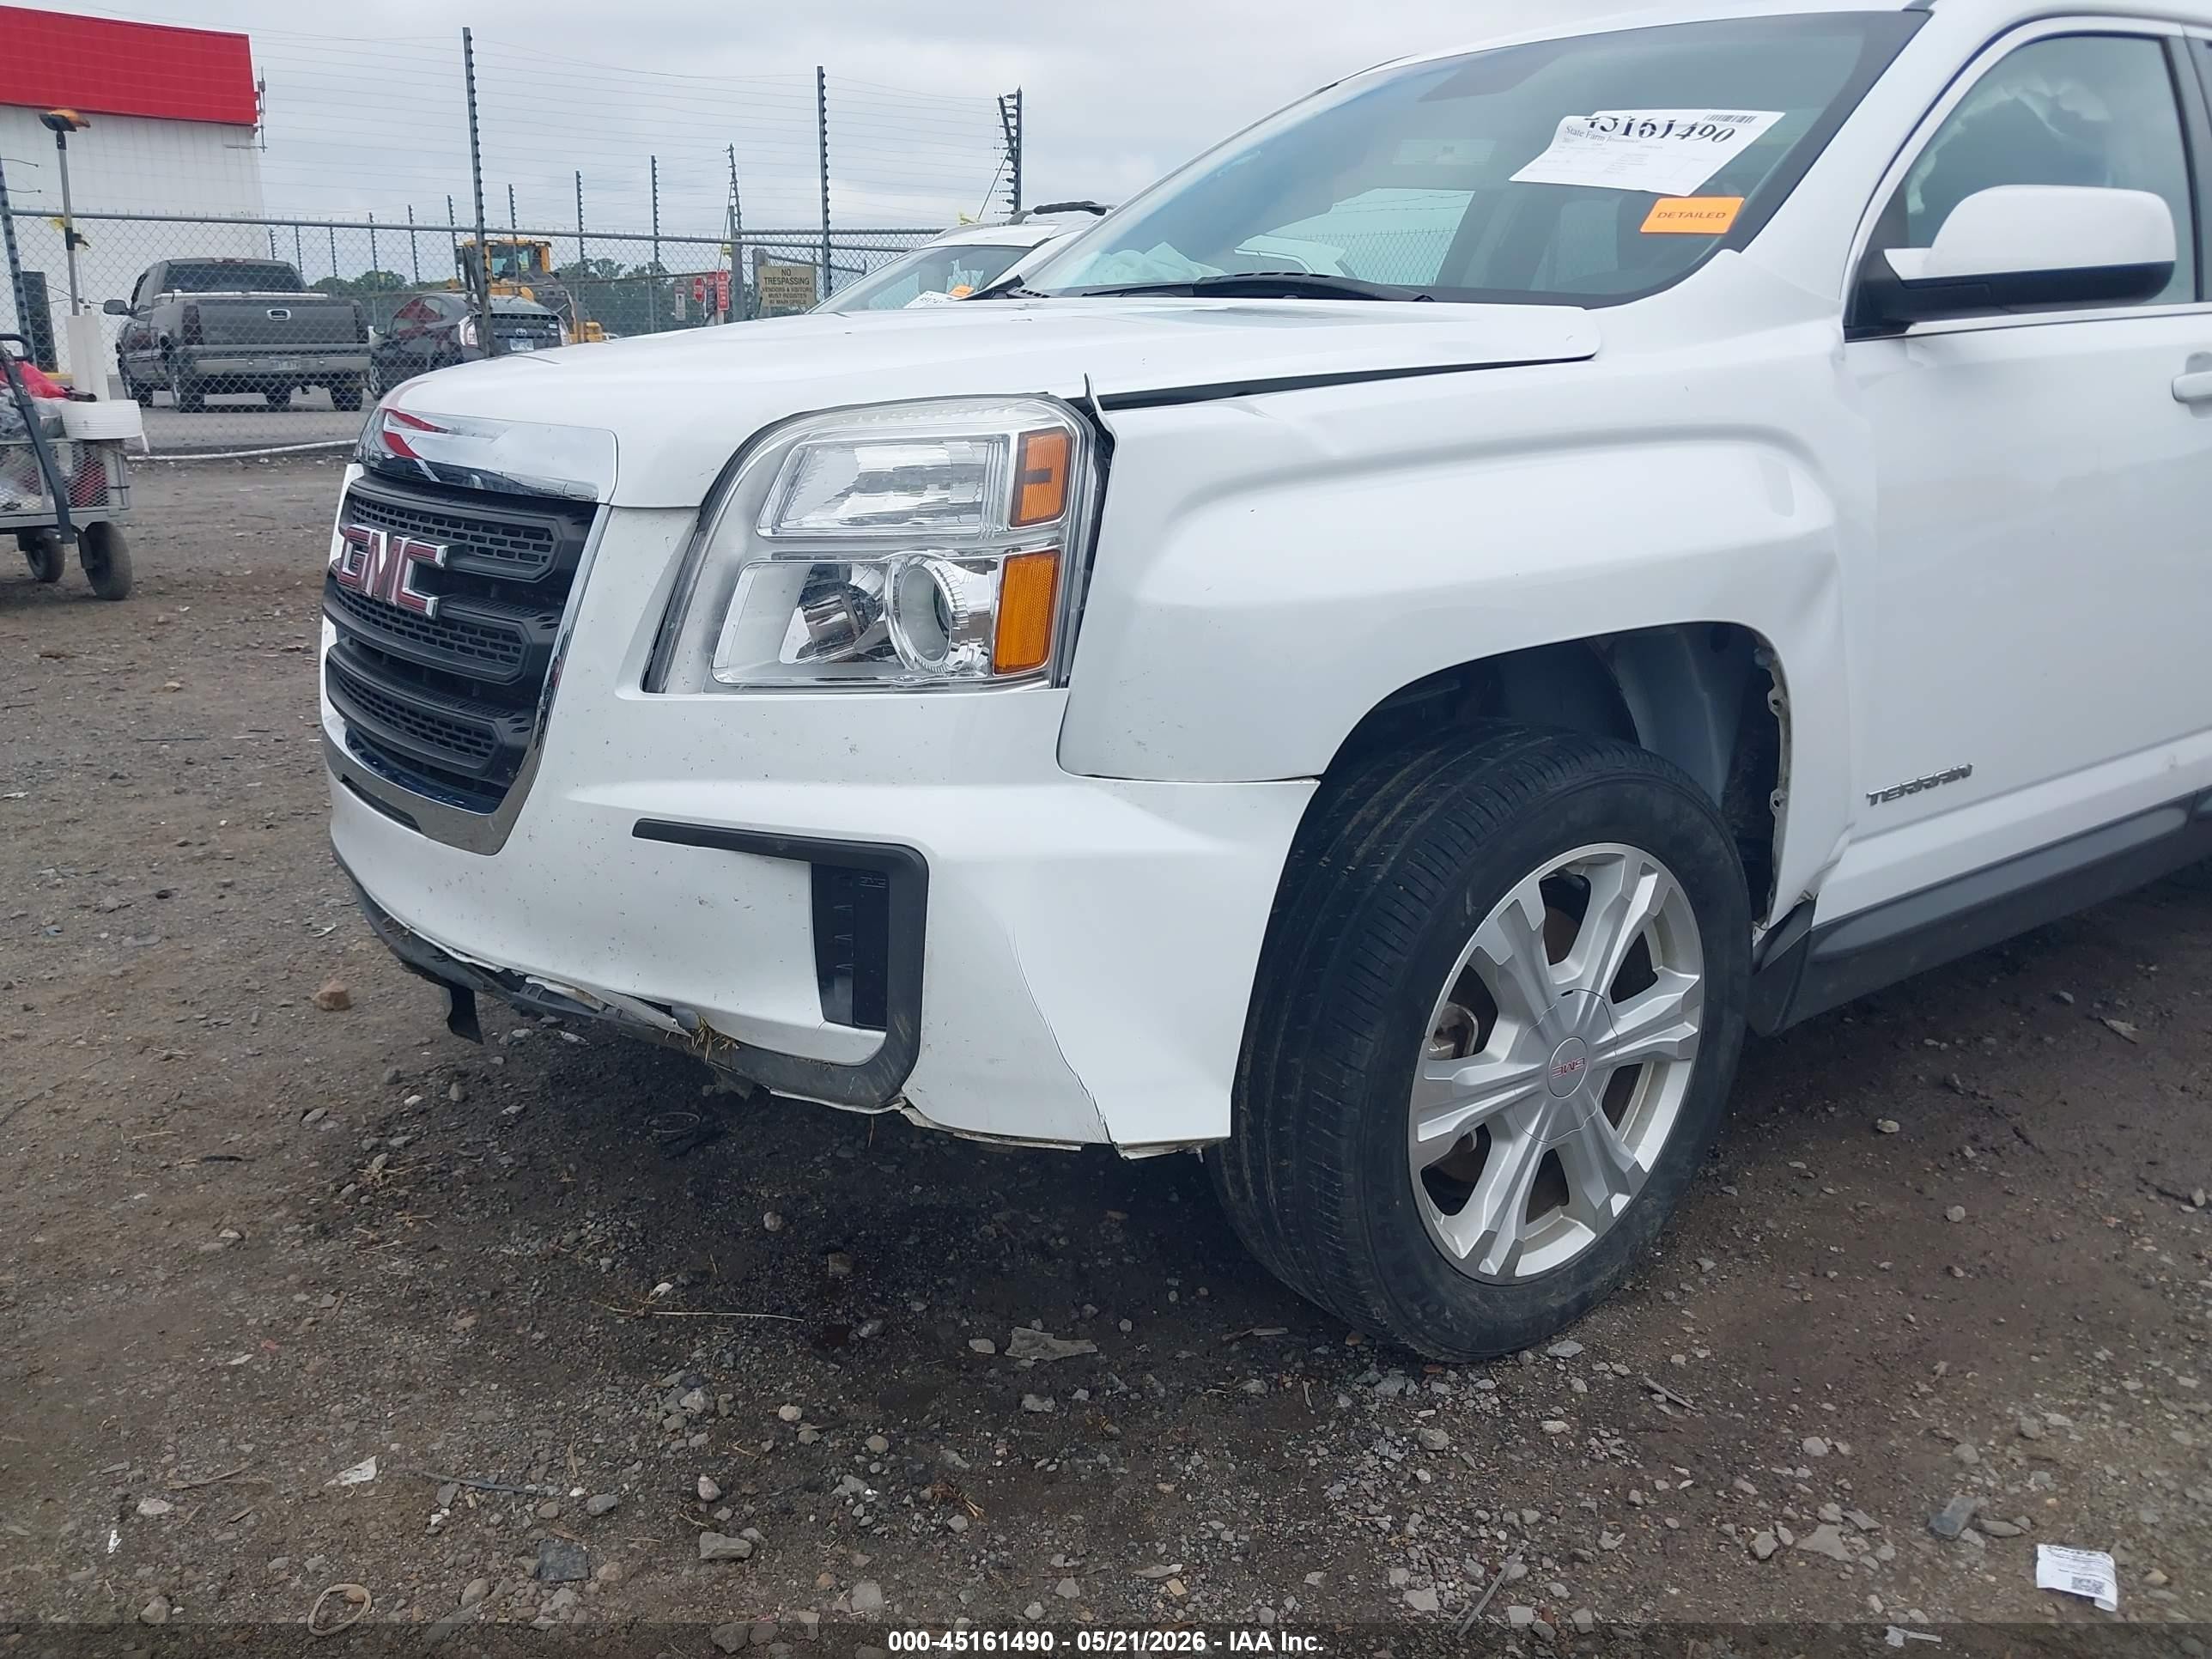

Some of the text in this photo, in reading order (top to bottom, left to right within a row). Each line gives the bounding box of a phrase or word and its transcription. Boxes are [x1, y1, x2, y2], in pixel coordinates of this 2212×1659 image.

[1565, 125, 1584, 137] State
[1585, 129, 1606, 143] Farm
[763, 276, 810, 285] TRESPASSING
[781, 268, 792, 276] NO
[337, 523, 448, 620] GMC
[1866, 763, 1973, 807] TERRAIN
[1552, 1057, 1585, 1079] GMC
